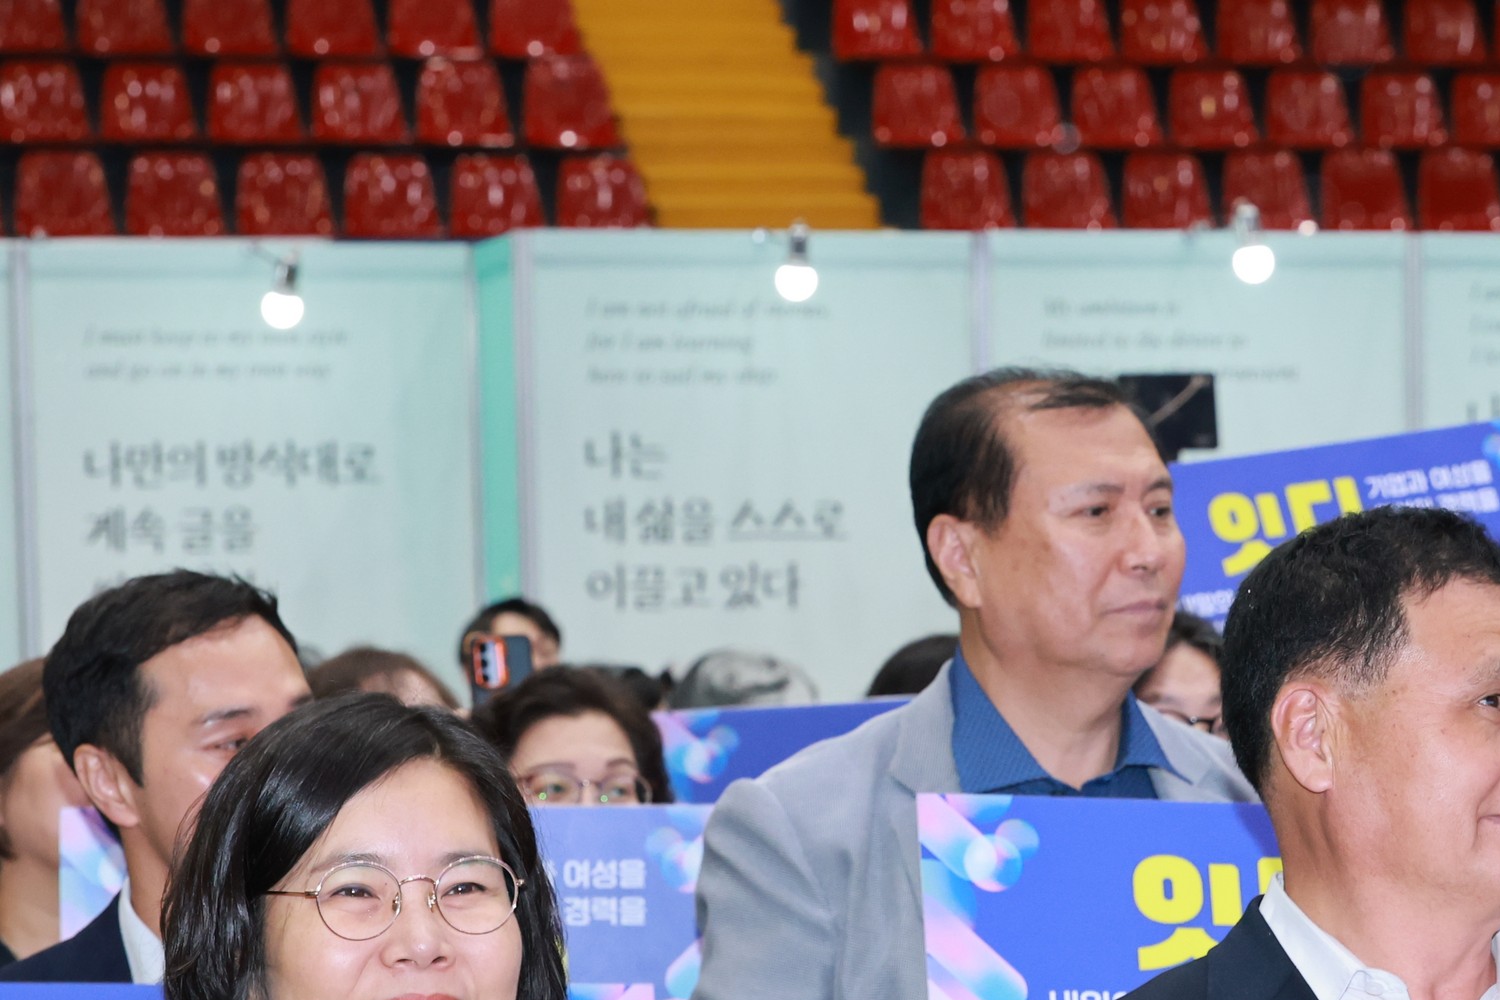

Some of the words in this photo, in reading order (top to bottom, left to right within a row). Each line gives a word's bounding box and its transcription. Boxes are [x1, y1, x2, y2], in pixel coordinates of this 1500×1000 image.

[82, 437, 207, 490] 나만의
[215, 437, 382, 489] 방식대로
[583, 430, 668, 481] 나는
[86, 504, 165, 552] 계속
[178, 504, 256, 551] 글을
[729, 496, 850, 543] 스스로
[584, 560, 712, 612] 이끌고
[718, 559, 801, 612] 있다
[563, 858, 646, 890] 여성을
[1132, 854, 1283, 972] 잇
